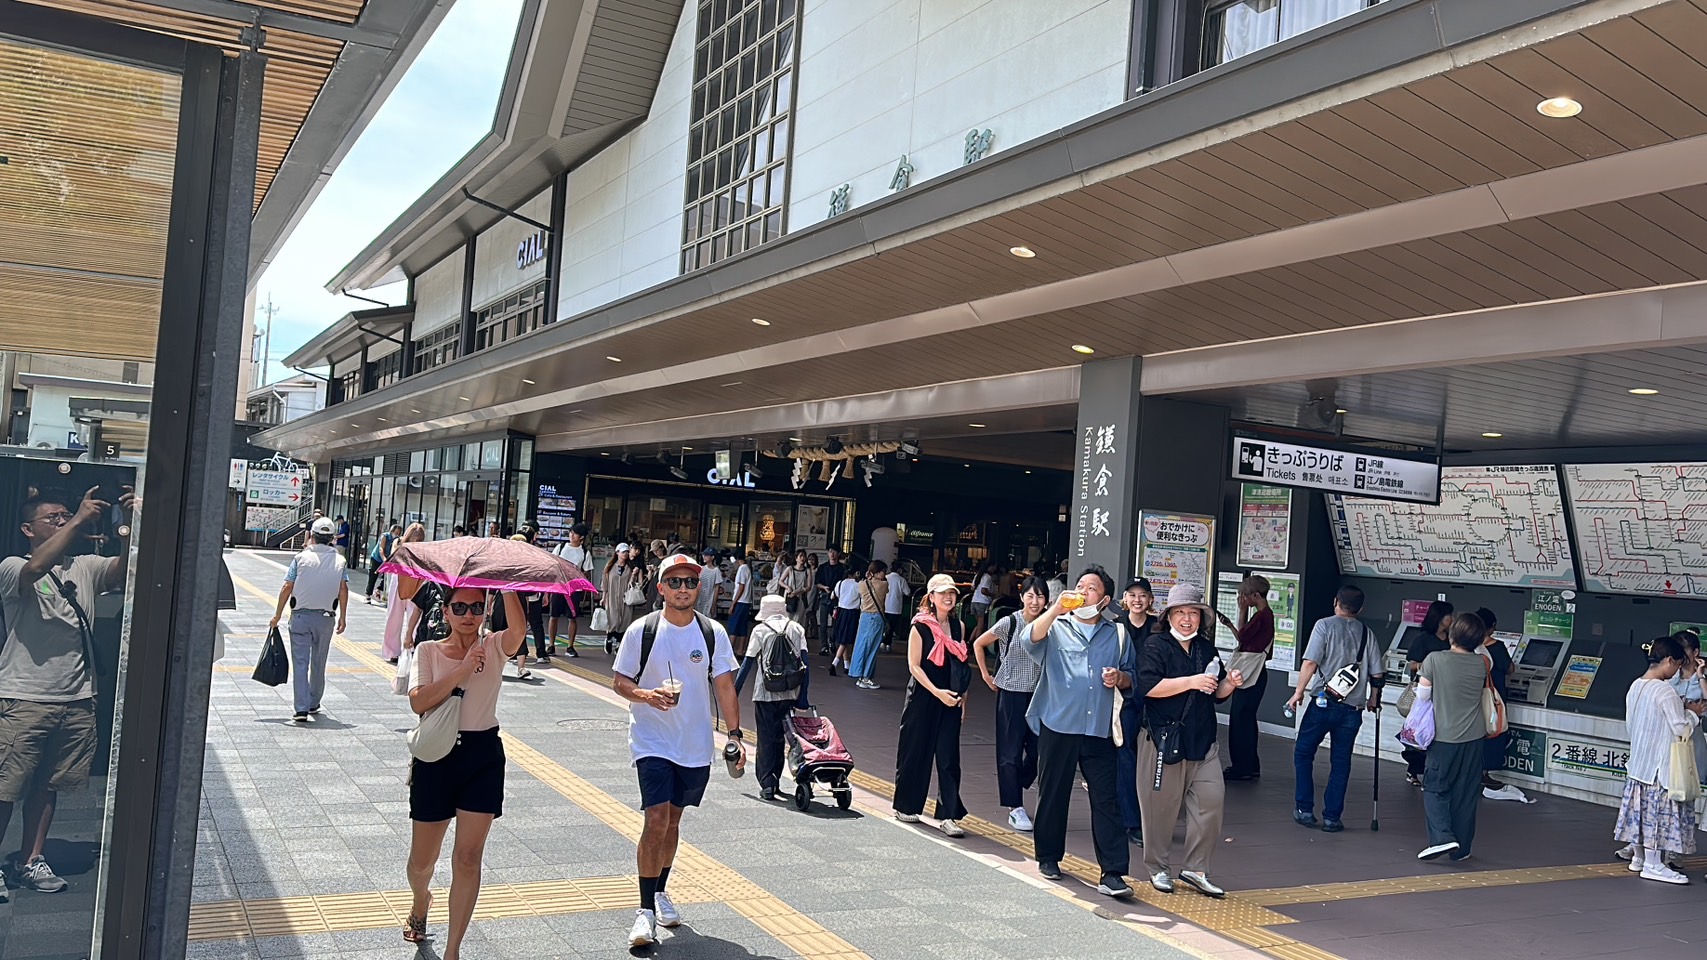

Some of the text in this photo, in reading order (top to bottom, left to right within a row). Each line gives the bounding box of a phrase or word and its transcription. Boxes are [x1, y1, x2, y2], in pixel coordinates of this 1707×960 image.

[516, 230, 544, 270] CIAL
[106, 445, 115, 455] 5
[1267, 447, 1344, 471] きっぷうりば
[1368, 460, 1384, 468] JR線
[707, 468, 756, 488] CAL
[1266, 467, 1296, 481] Tickets
[1090, 424, 1116, 537] 鎌倉駅
[1367, 476, 1404, 488] 江ノ島電鉄線
[1077, 427, 1094, 557] Kamakura Station
[1160, 522, 1196, 532] おでかけに
[1157, 531, 1198, 543] 便利なきっぷ
[1538, 594, 1560, 604] 江ノ電
[1535, 603, 1562, 611] ENODEN
